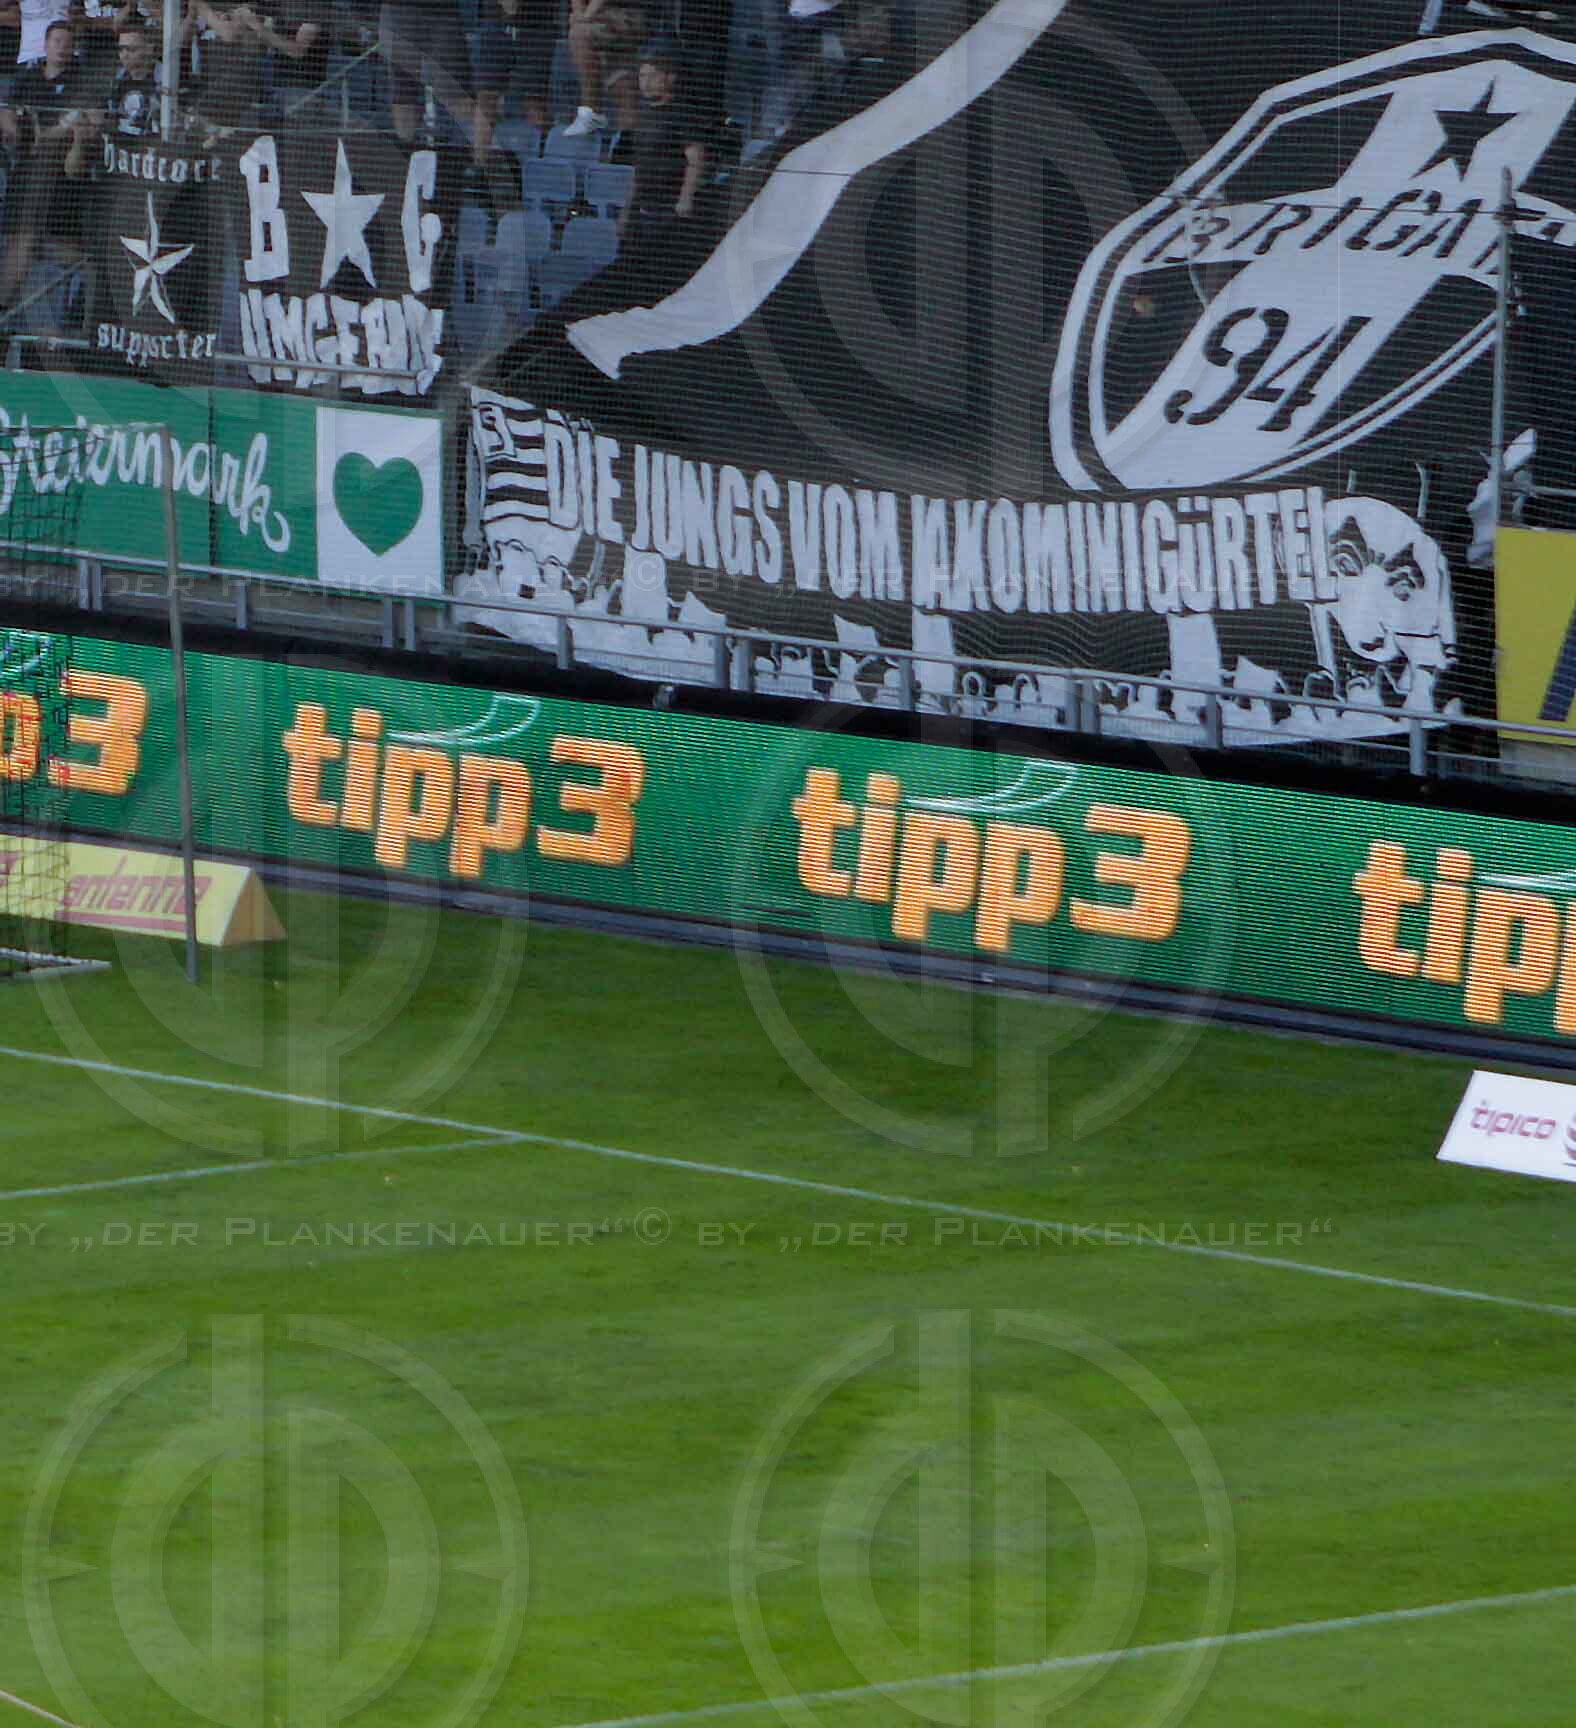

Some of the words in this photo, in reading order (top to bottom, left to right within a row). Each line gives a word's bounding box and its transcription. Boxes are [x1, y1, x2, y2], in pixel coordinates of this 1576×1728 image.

[1164, 306, 1373, 432] 94
[633, 442, 785, 585] JUNGS
[788, 481, 905, 603] VOM
[283, 702, 646, 877] tipp3
[794, 767, 1191, 951] tipp3
[1354, 841, 1576, 1035] tip
[1471, 1099, 1556, 1139] tipico
